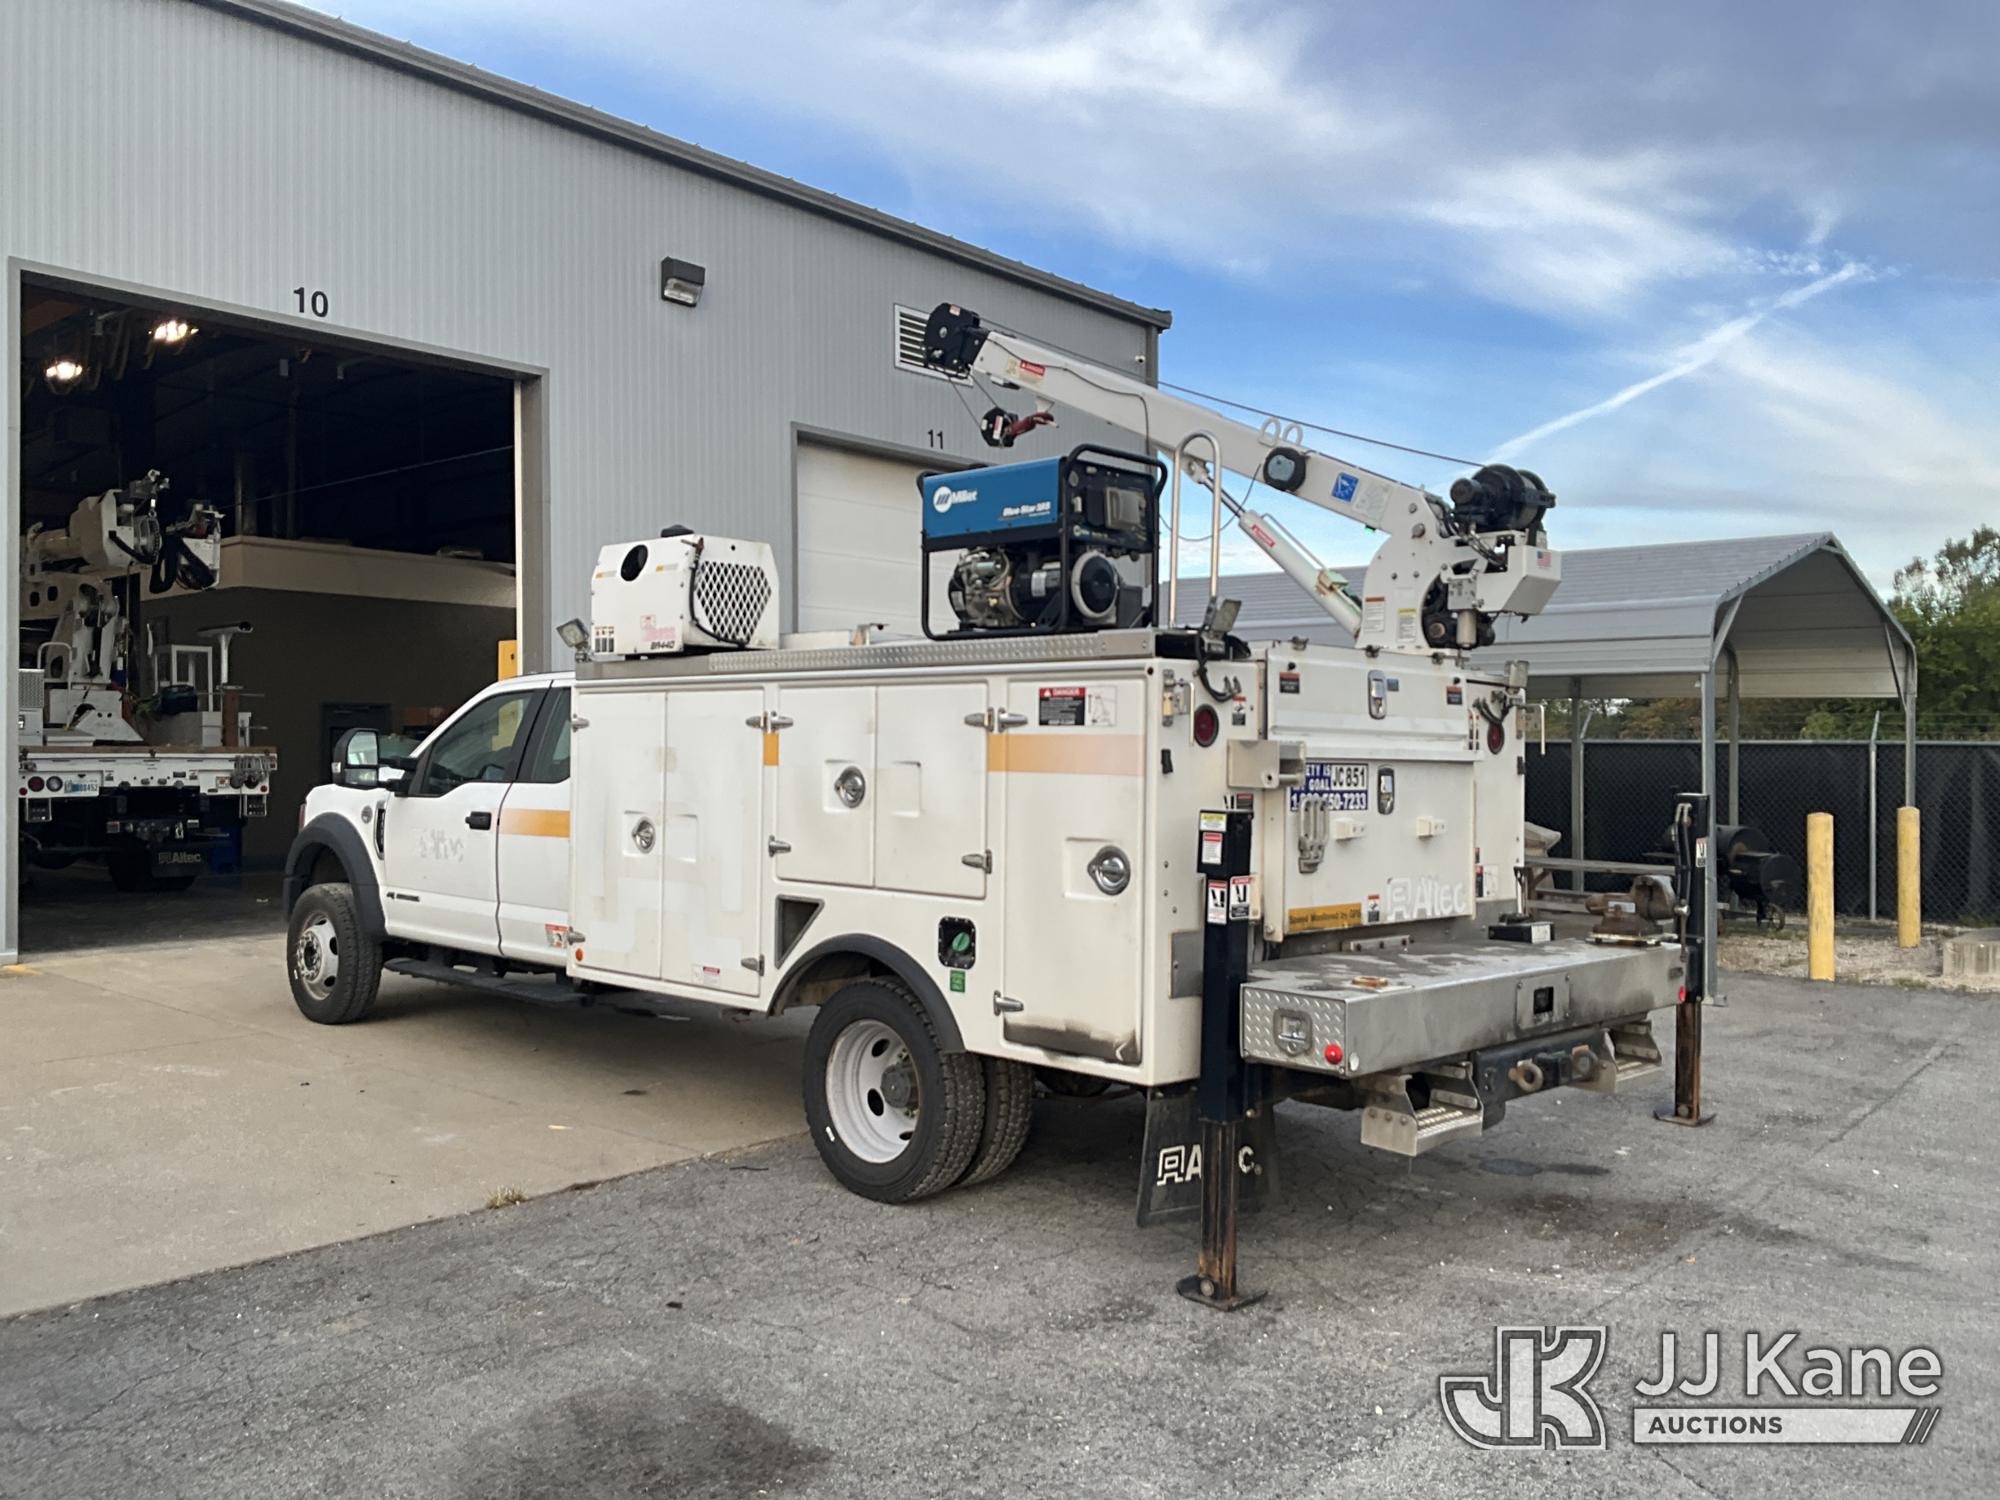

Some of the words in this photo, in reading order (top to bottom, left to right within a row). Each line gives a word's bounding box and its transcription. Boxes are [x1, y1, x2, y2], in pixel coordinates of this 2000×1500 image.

[293, 286, 329, 317] 10
[927, 429, 943, 449] 11
[952, 489, 977, 504] Miller
[1309, 778, 1330, 791] GOAL
[1346, 766, 1365, 787] 851
